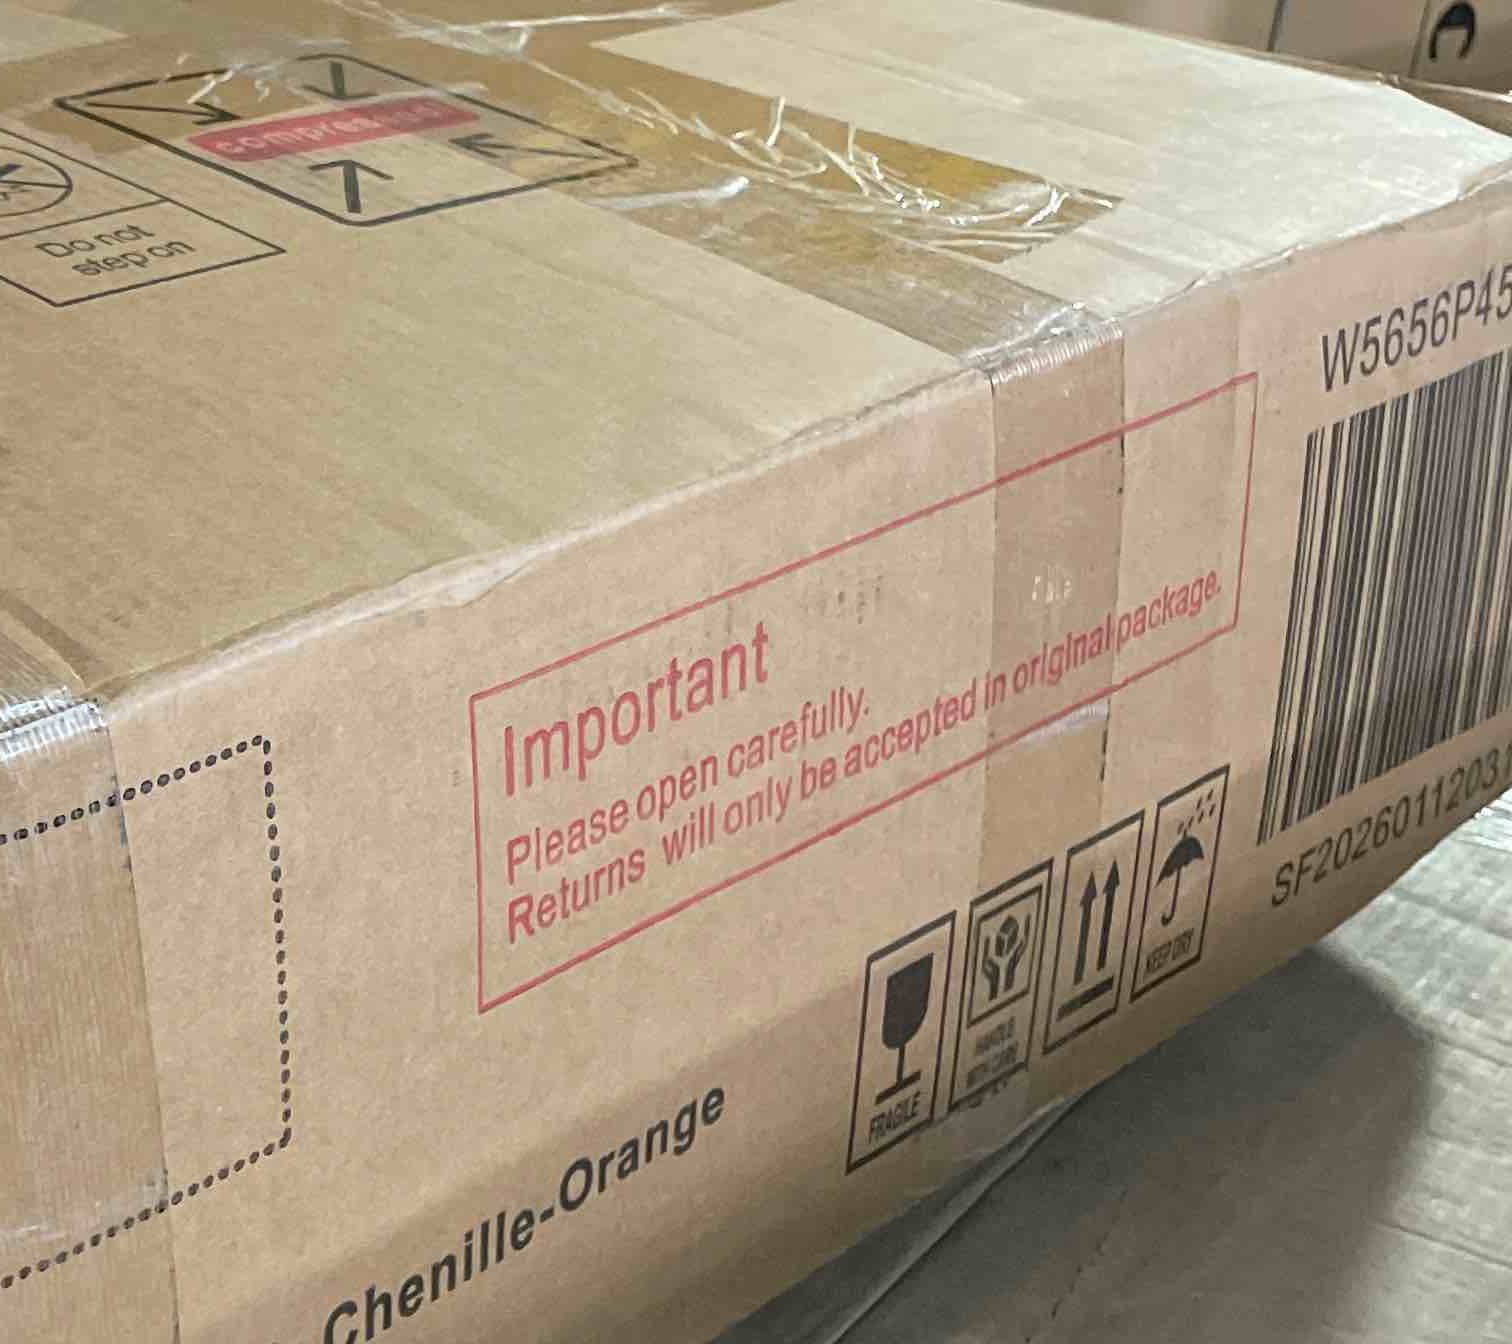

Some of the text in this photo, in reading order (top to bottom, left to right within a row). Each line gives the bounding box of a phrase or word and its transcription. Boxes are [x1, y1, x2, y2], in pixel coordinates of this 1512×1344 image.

[35, 224, 155, 257] Do not
[72, 241, 196, 275] step on
[504, 621, 769, 797] Important
[506, 570, 1222, 945] Returns will only be accepted in original package.
[506, 685, 870, 886] Please open carefully.
[868, 1090, 921, 1145] FRAGILE
